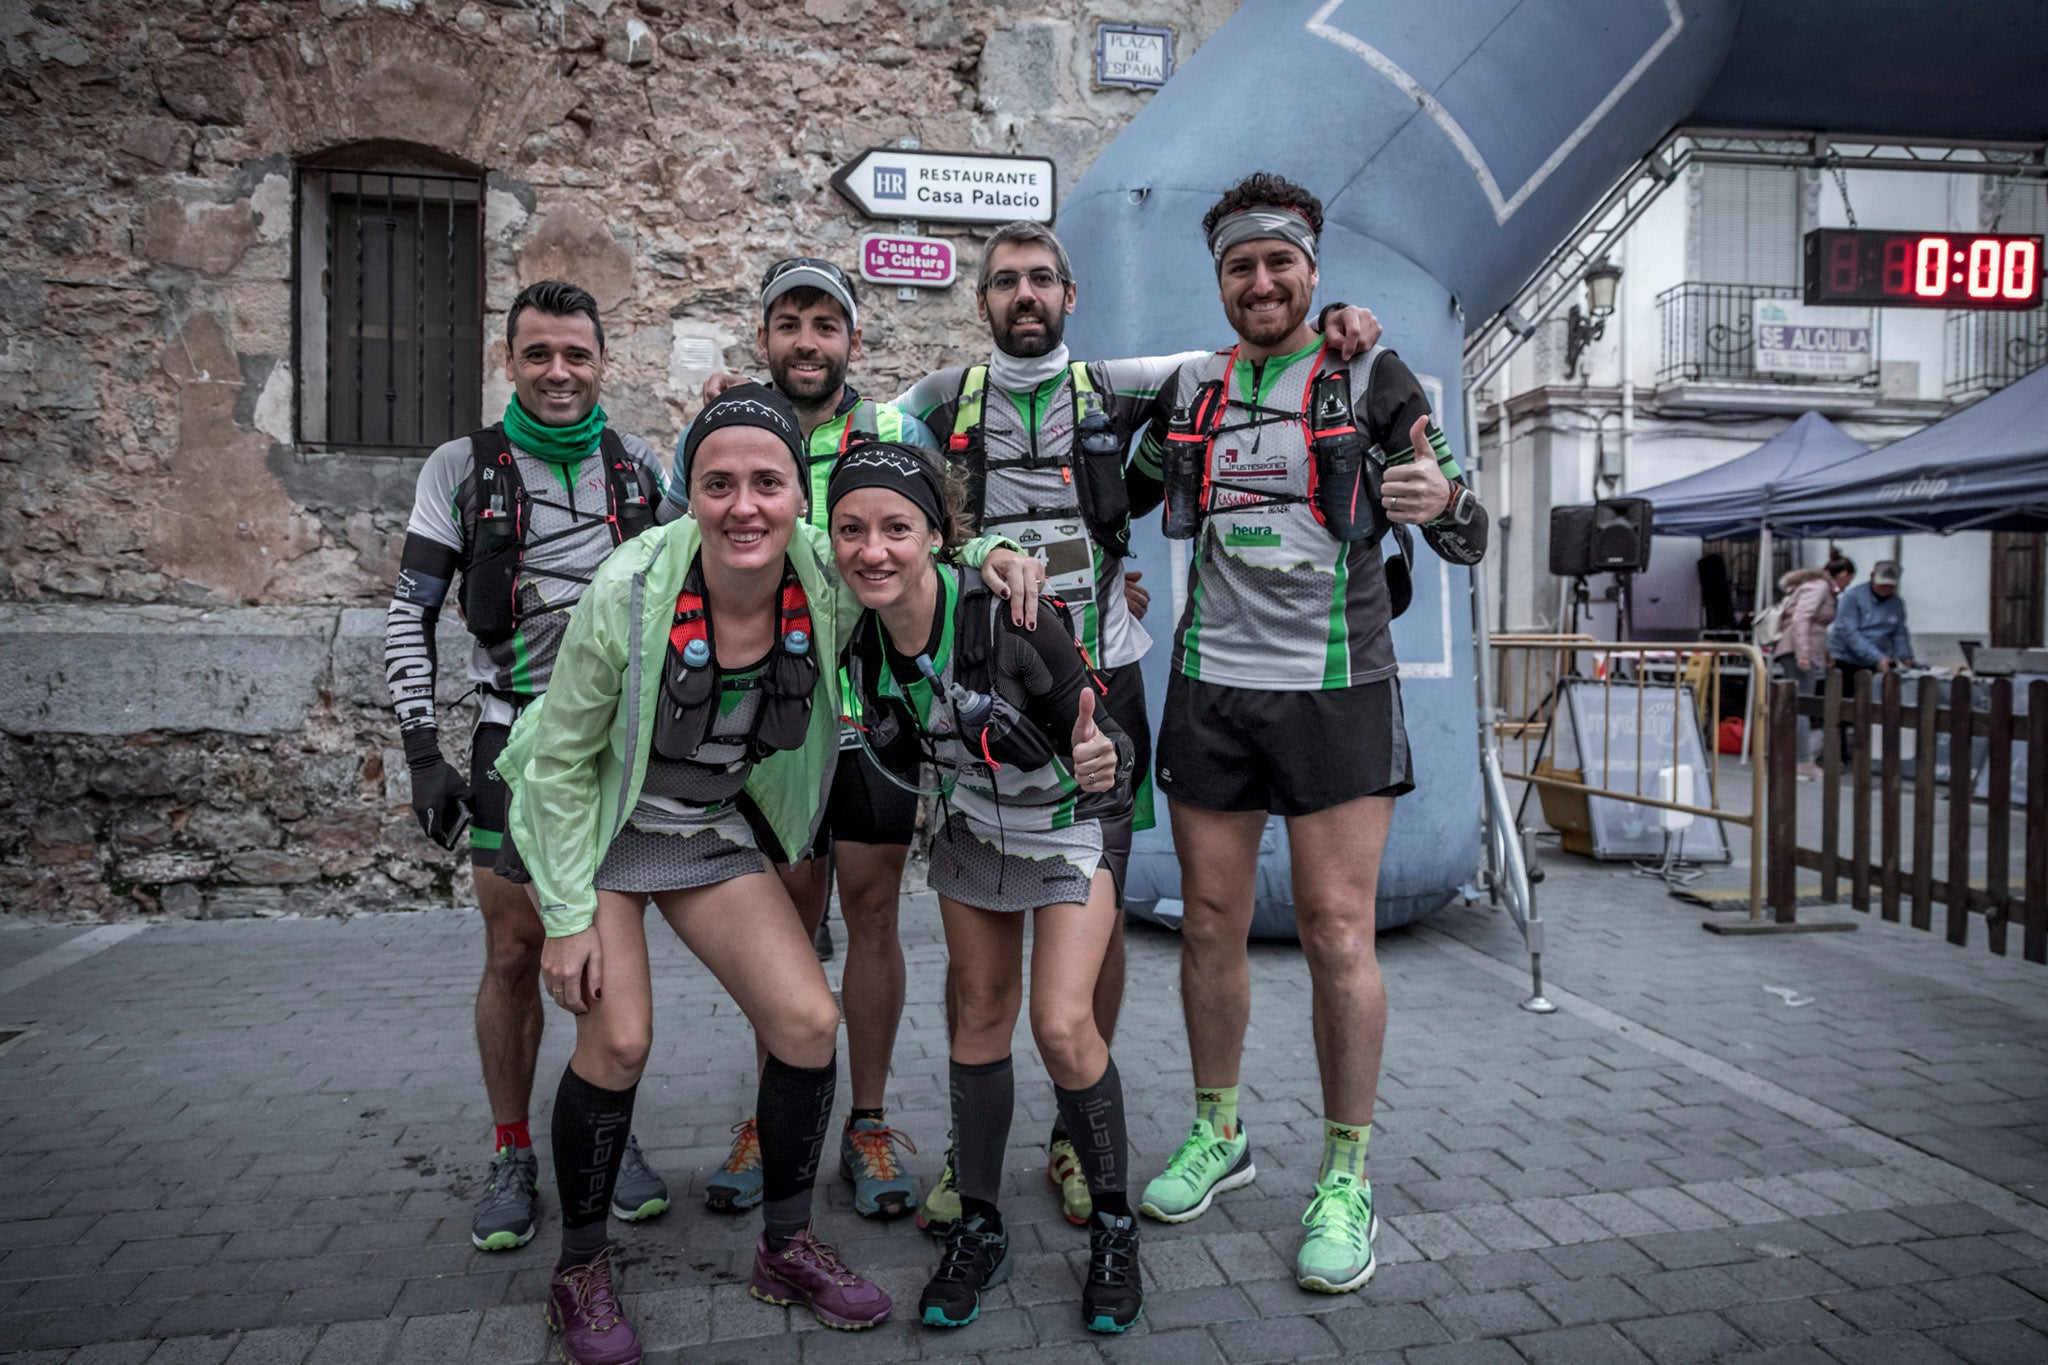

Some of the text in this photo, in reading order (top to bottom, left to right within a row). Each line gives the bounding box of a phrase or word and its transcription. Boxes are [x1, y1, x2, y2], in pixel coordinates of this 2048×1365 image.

[1111, 34, 1158, 50] PLAZA
[1125, 50, 1142, 62] DE
[1105, 61, 1162, 77] ESPAÑA
[920, 168, 1037, 185] RESTAURANTE
[917, 187, 1040, 207] Casa Palacio
[878, 240, 939, 256] Casa de
[870, 252, 945, 269] la Cultura
[1915, 238, 2035, 299] 0:00
[1761, 327, 1869, 352] SE ALQUILA
[1232, 523, 1273, 536] heura
